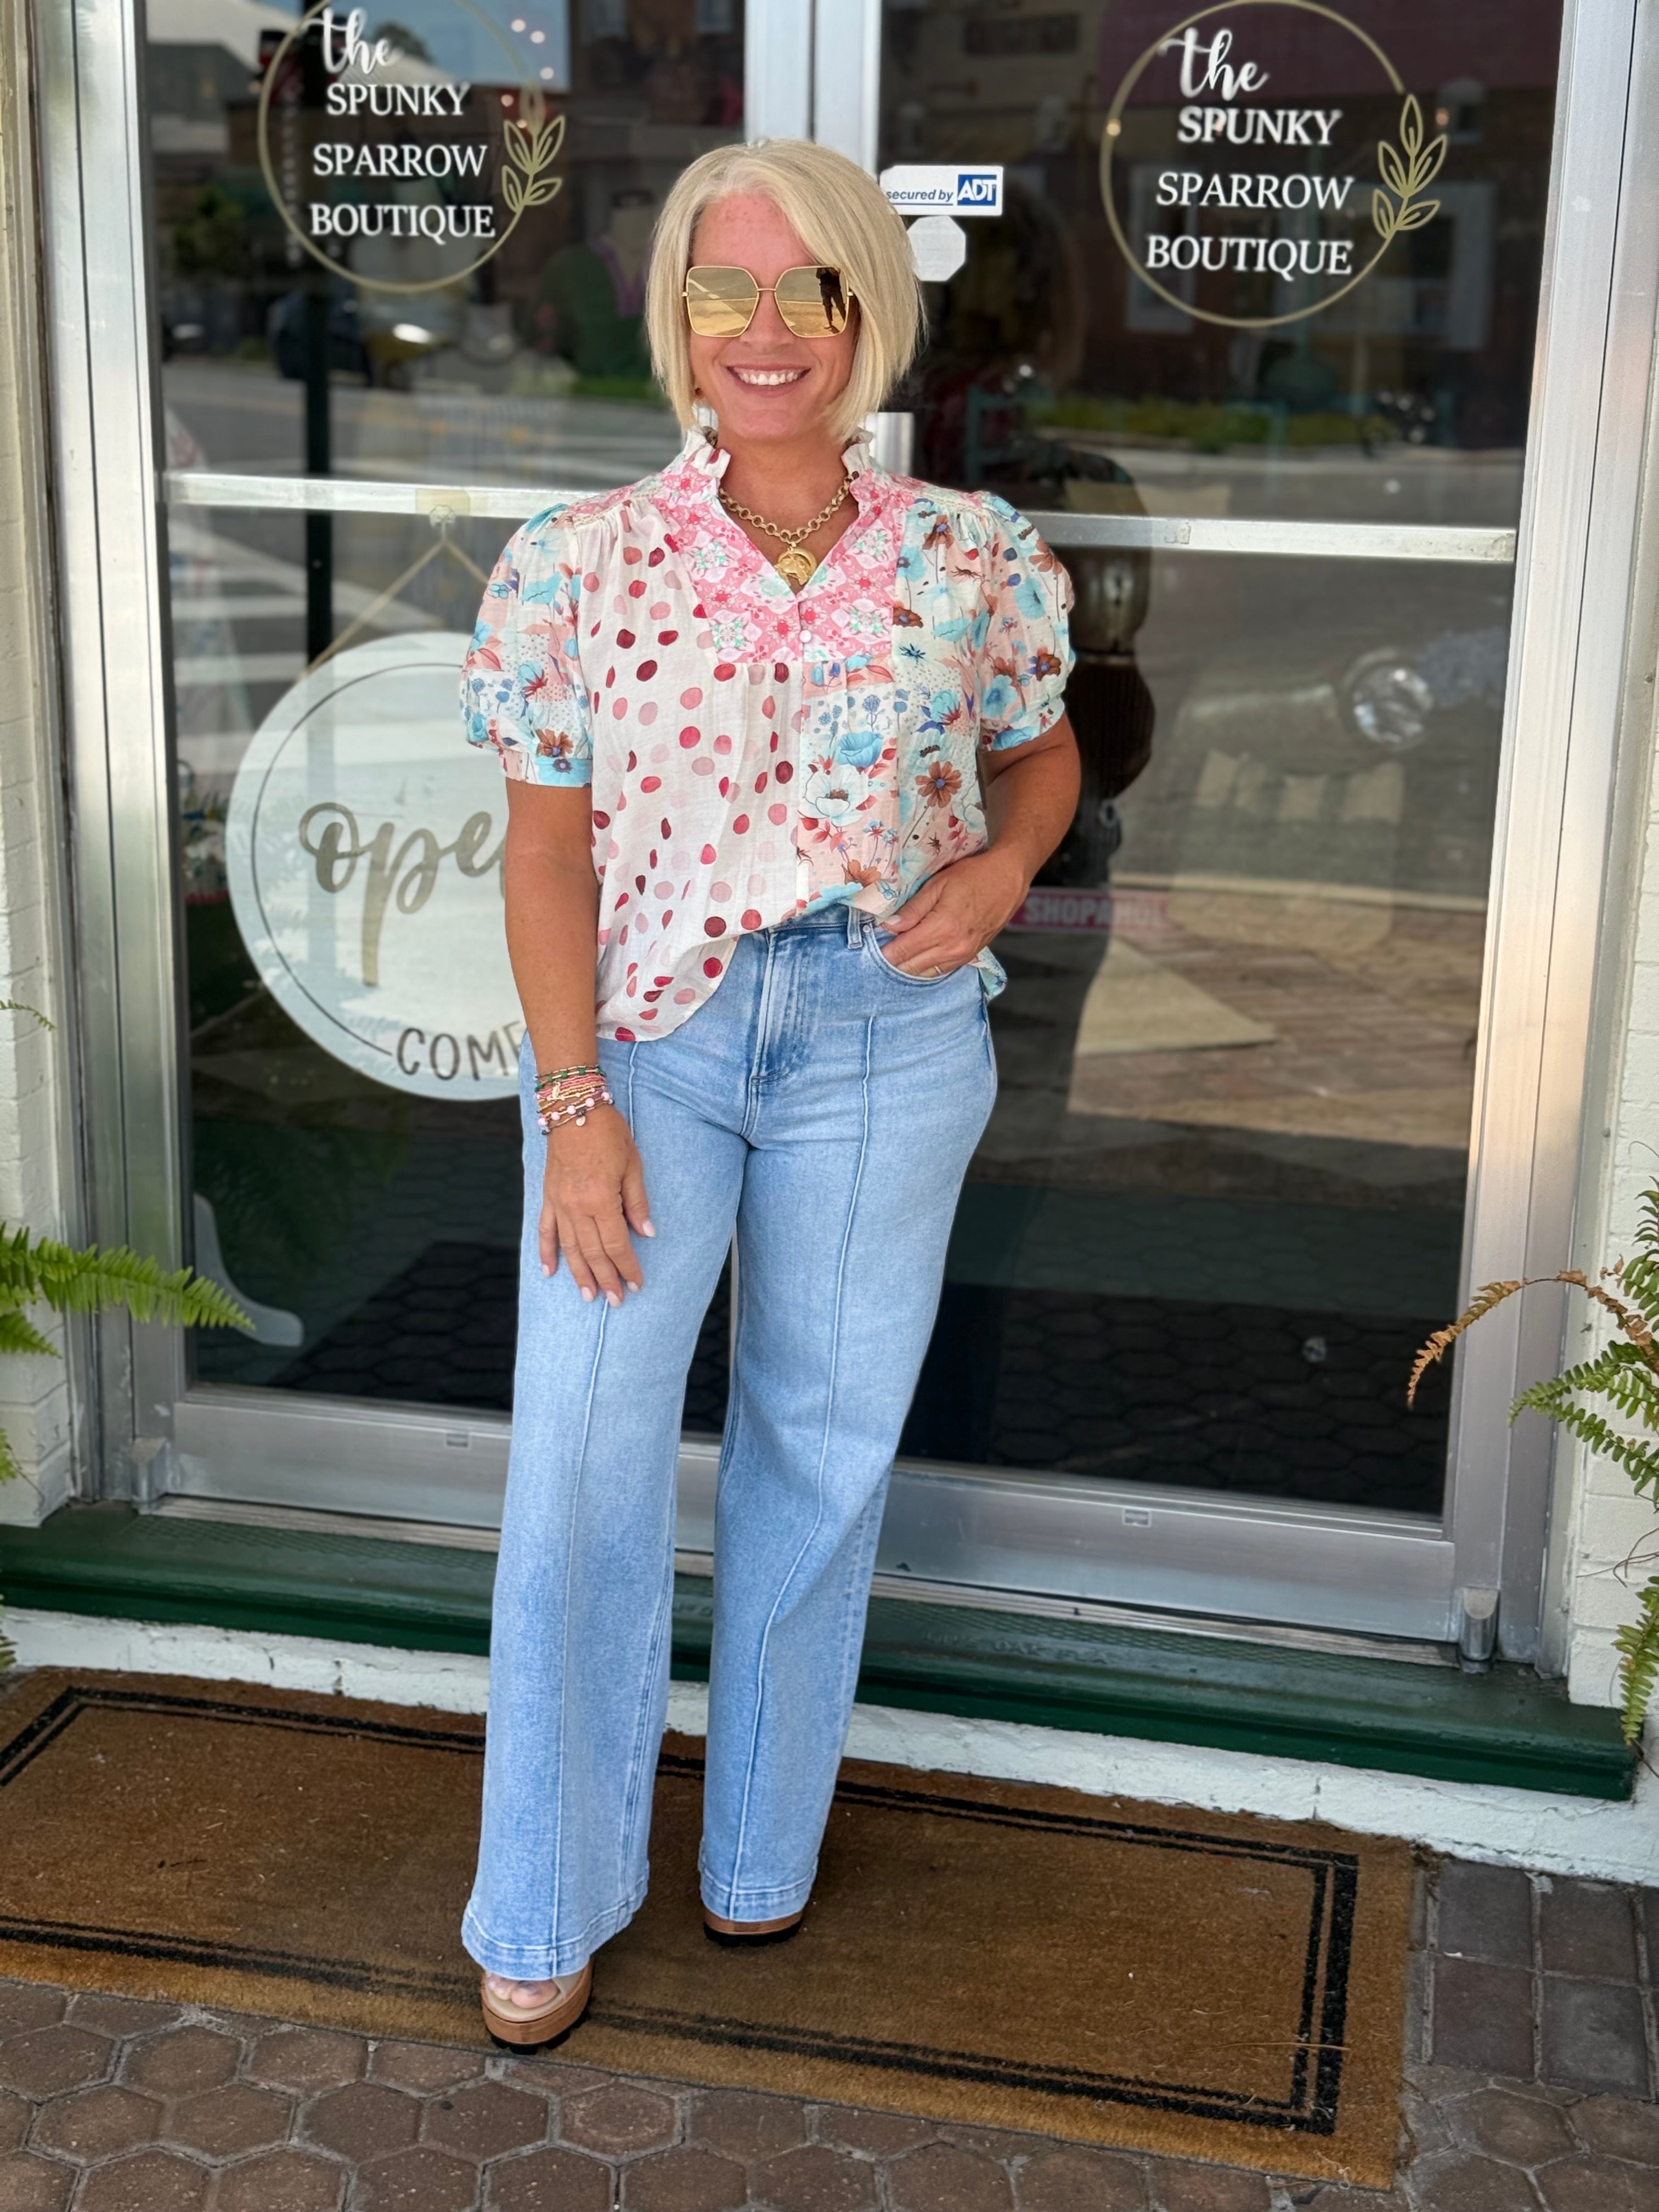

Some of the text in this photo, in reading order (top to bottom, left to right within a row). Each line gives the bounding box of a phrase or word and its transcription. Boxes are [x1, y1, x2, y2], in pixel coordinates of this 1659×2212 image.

[302, 7, 403, 75] the
[1157, 27, 1269, 101] the
[326, 83, 470, 117] SPUNKY
[1177, 106, 1343, 146] SPUNKY
[313, 143, 488, 178] SPARROW
[886, 179, 998, 202] secured by ADT
[1155, 171, 1355, 210] SPARROW
[309, 203, 496, 245] BOUTIQUE
[1146, 234, 1354, 281] BOUTIQUE
[298, 802, 507, 986] ope
